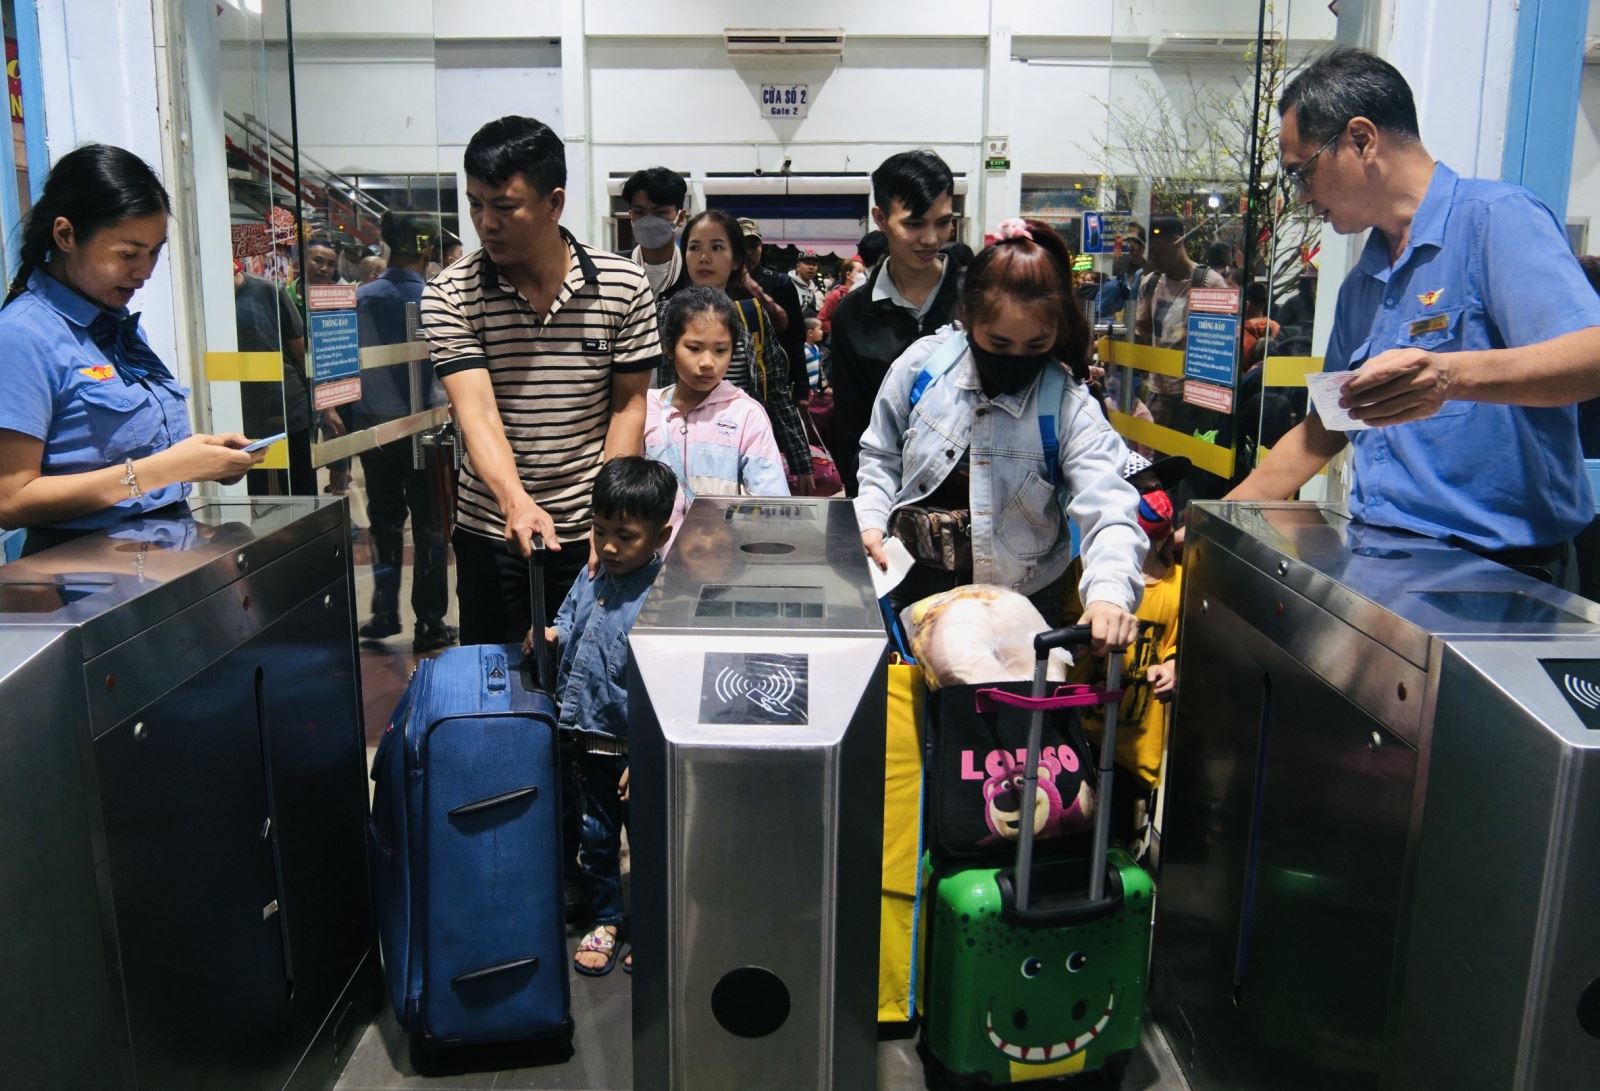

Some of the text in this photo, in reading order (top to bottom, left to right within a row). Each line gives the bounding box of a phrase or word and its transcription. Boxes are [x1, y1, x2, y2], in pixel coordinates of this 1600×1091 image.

[763, 84, 807, 104] CỬA SỐ 2
[771, 107, 798, 115] Gate 2
